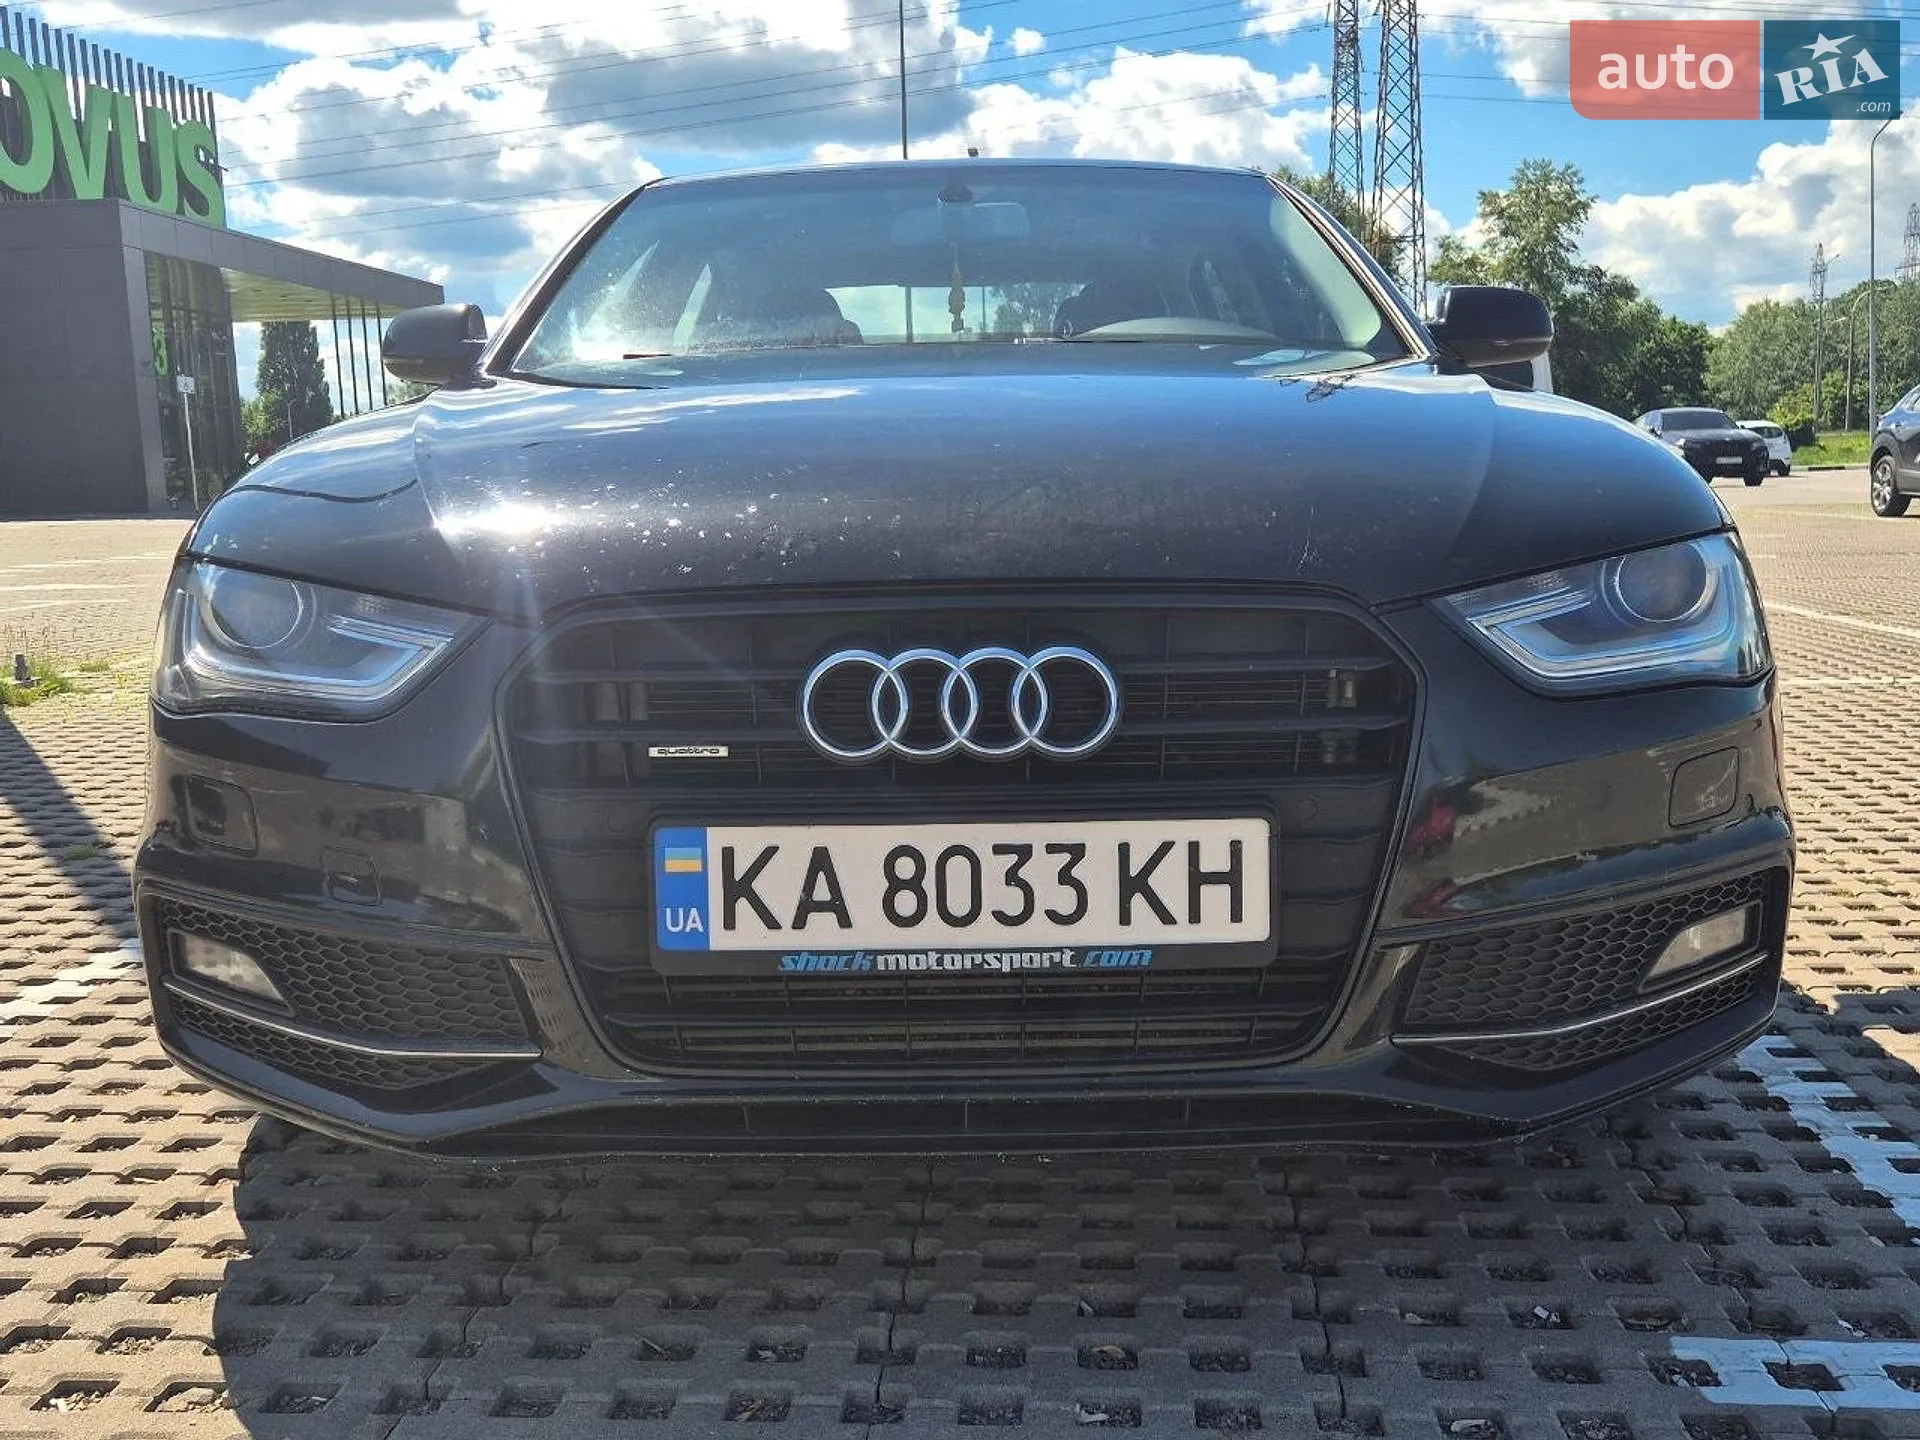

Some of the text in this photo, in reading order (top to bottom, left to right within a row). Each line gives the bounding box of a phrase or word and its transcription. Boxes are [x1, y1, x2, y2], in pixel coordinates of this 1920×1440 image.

[656, 747, 720, 756] quattro
[721, 840, 1244, 930] KA 8033 KH
[665, 907, 704, 933] UA
